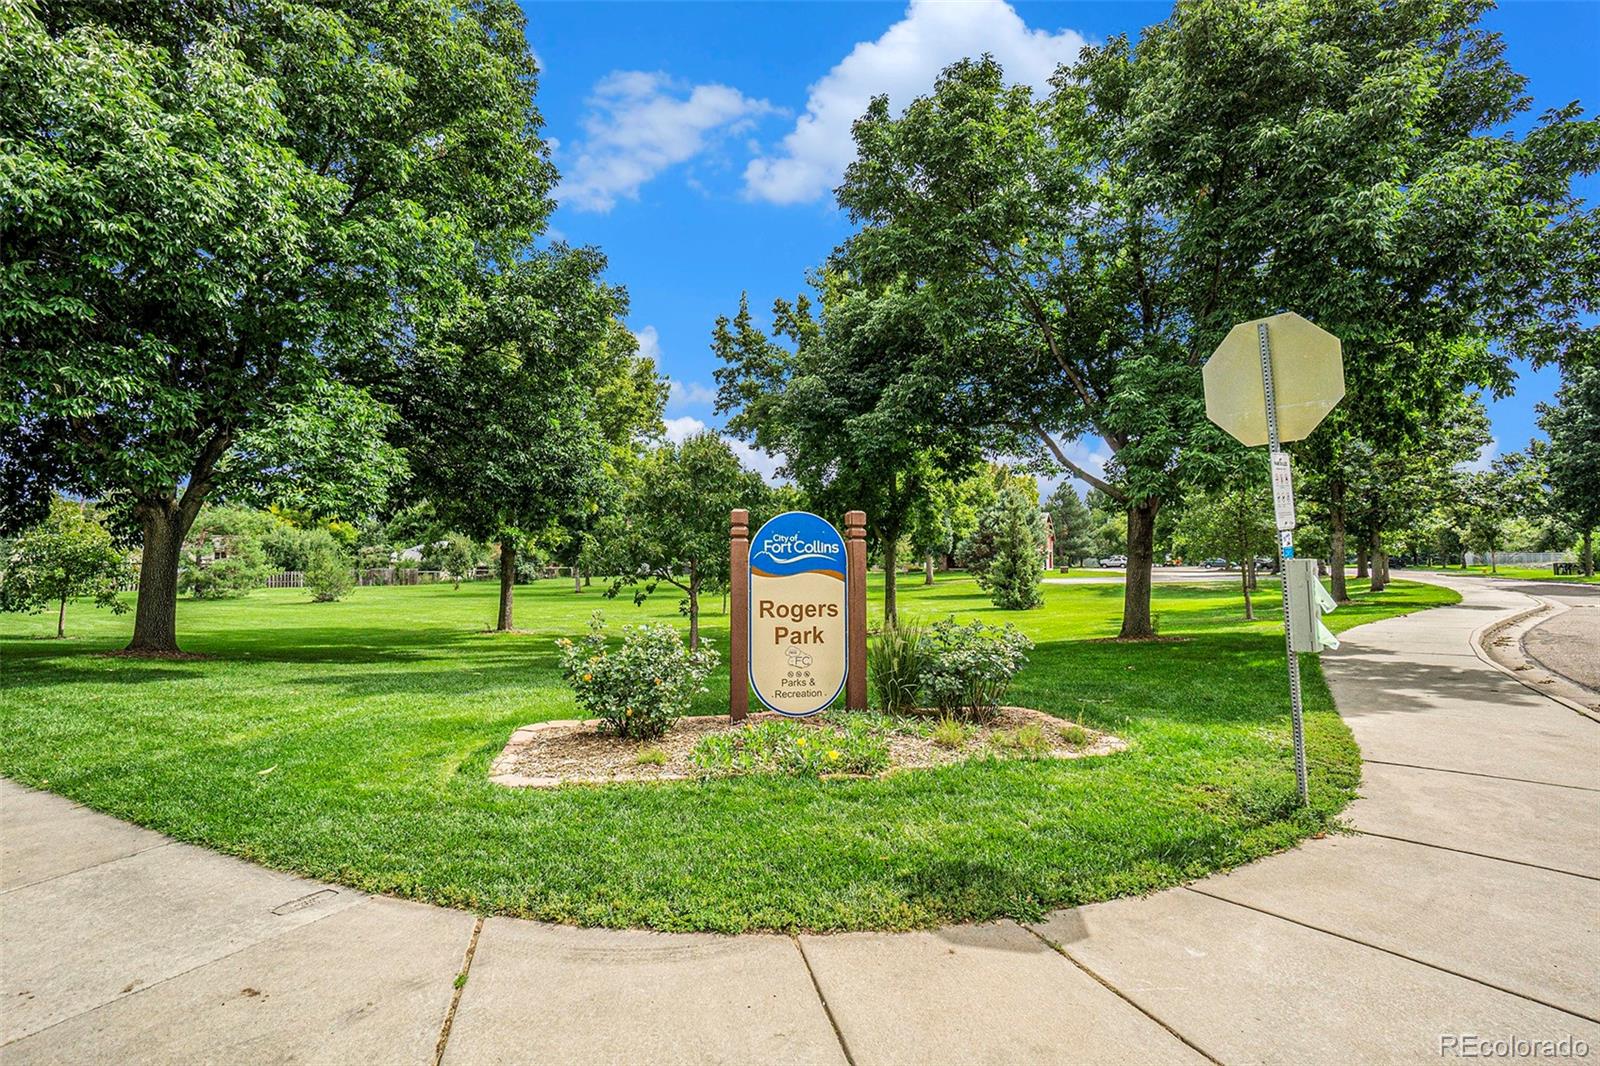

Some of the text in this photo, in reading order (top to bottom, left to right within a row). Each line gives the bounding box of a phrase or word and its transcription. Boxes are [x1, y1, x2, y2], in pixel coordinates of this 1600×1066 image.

[773, 533, 798, 543] City of
[764, 540, 839, 553] Fort Collins
[759, 600, 839, 623] Rogers
[774, 626, 824, 645] Park
[781, 678, 816, 687] Parks &
[774, 690, 823, 699] Recreation
